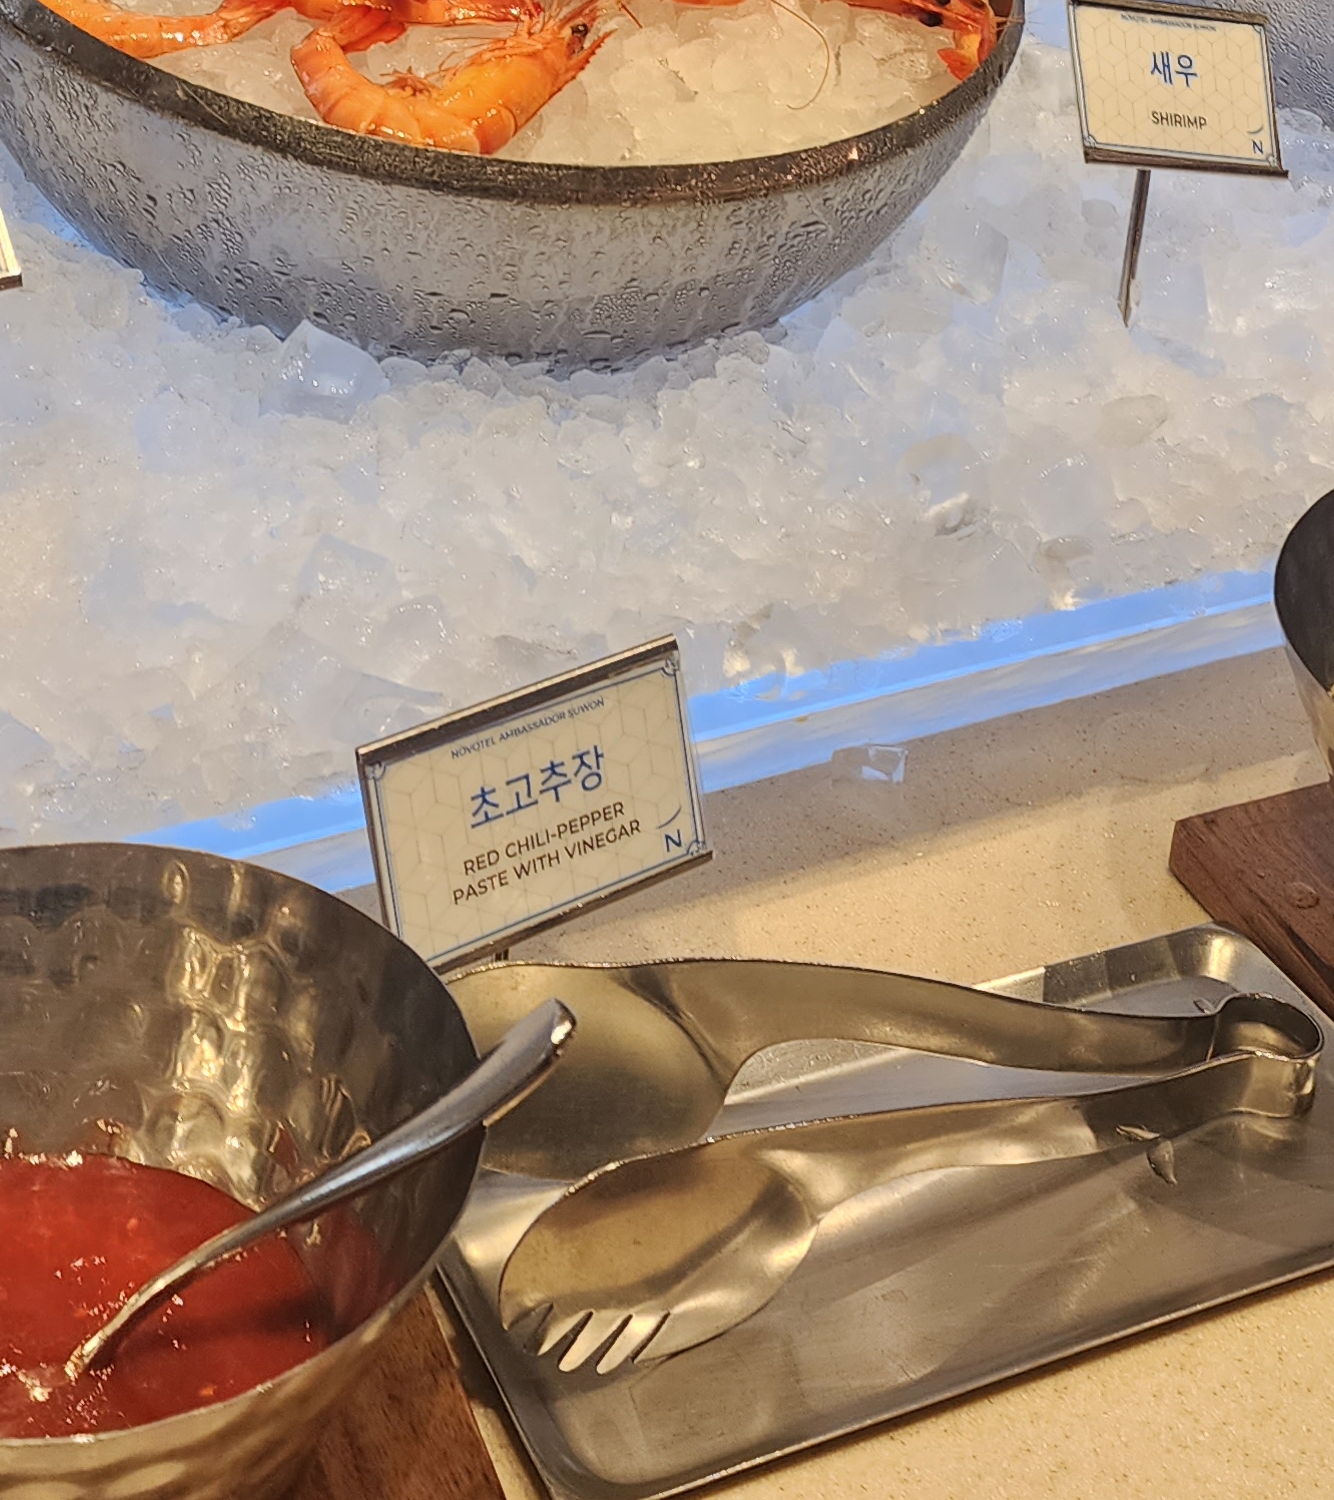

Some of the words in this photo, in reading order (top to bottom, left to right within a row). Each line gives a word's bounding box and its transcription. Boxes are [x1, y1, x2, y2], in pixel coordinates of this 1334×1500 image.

[1150, 51, 1198, 87] 새우
[1151, 110, 1207, 130] SHIRIMP
[450, 737, 497, 760] NOVOTEL
[499, 712, 566, 743] AMBASSADOR
[567, 697, 605, 718] SUWON
[470, 744, 605, 829] 초고추장
[452, 870, 509, 905] PASTE
[514, 851, 562, 880] WITH
[564, 818, 642, 860] VINEGAR
[462, 849, 500, 876] RED
[505, 801, 626, 860] CHILI-PEPPER
